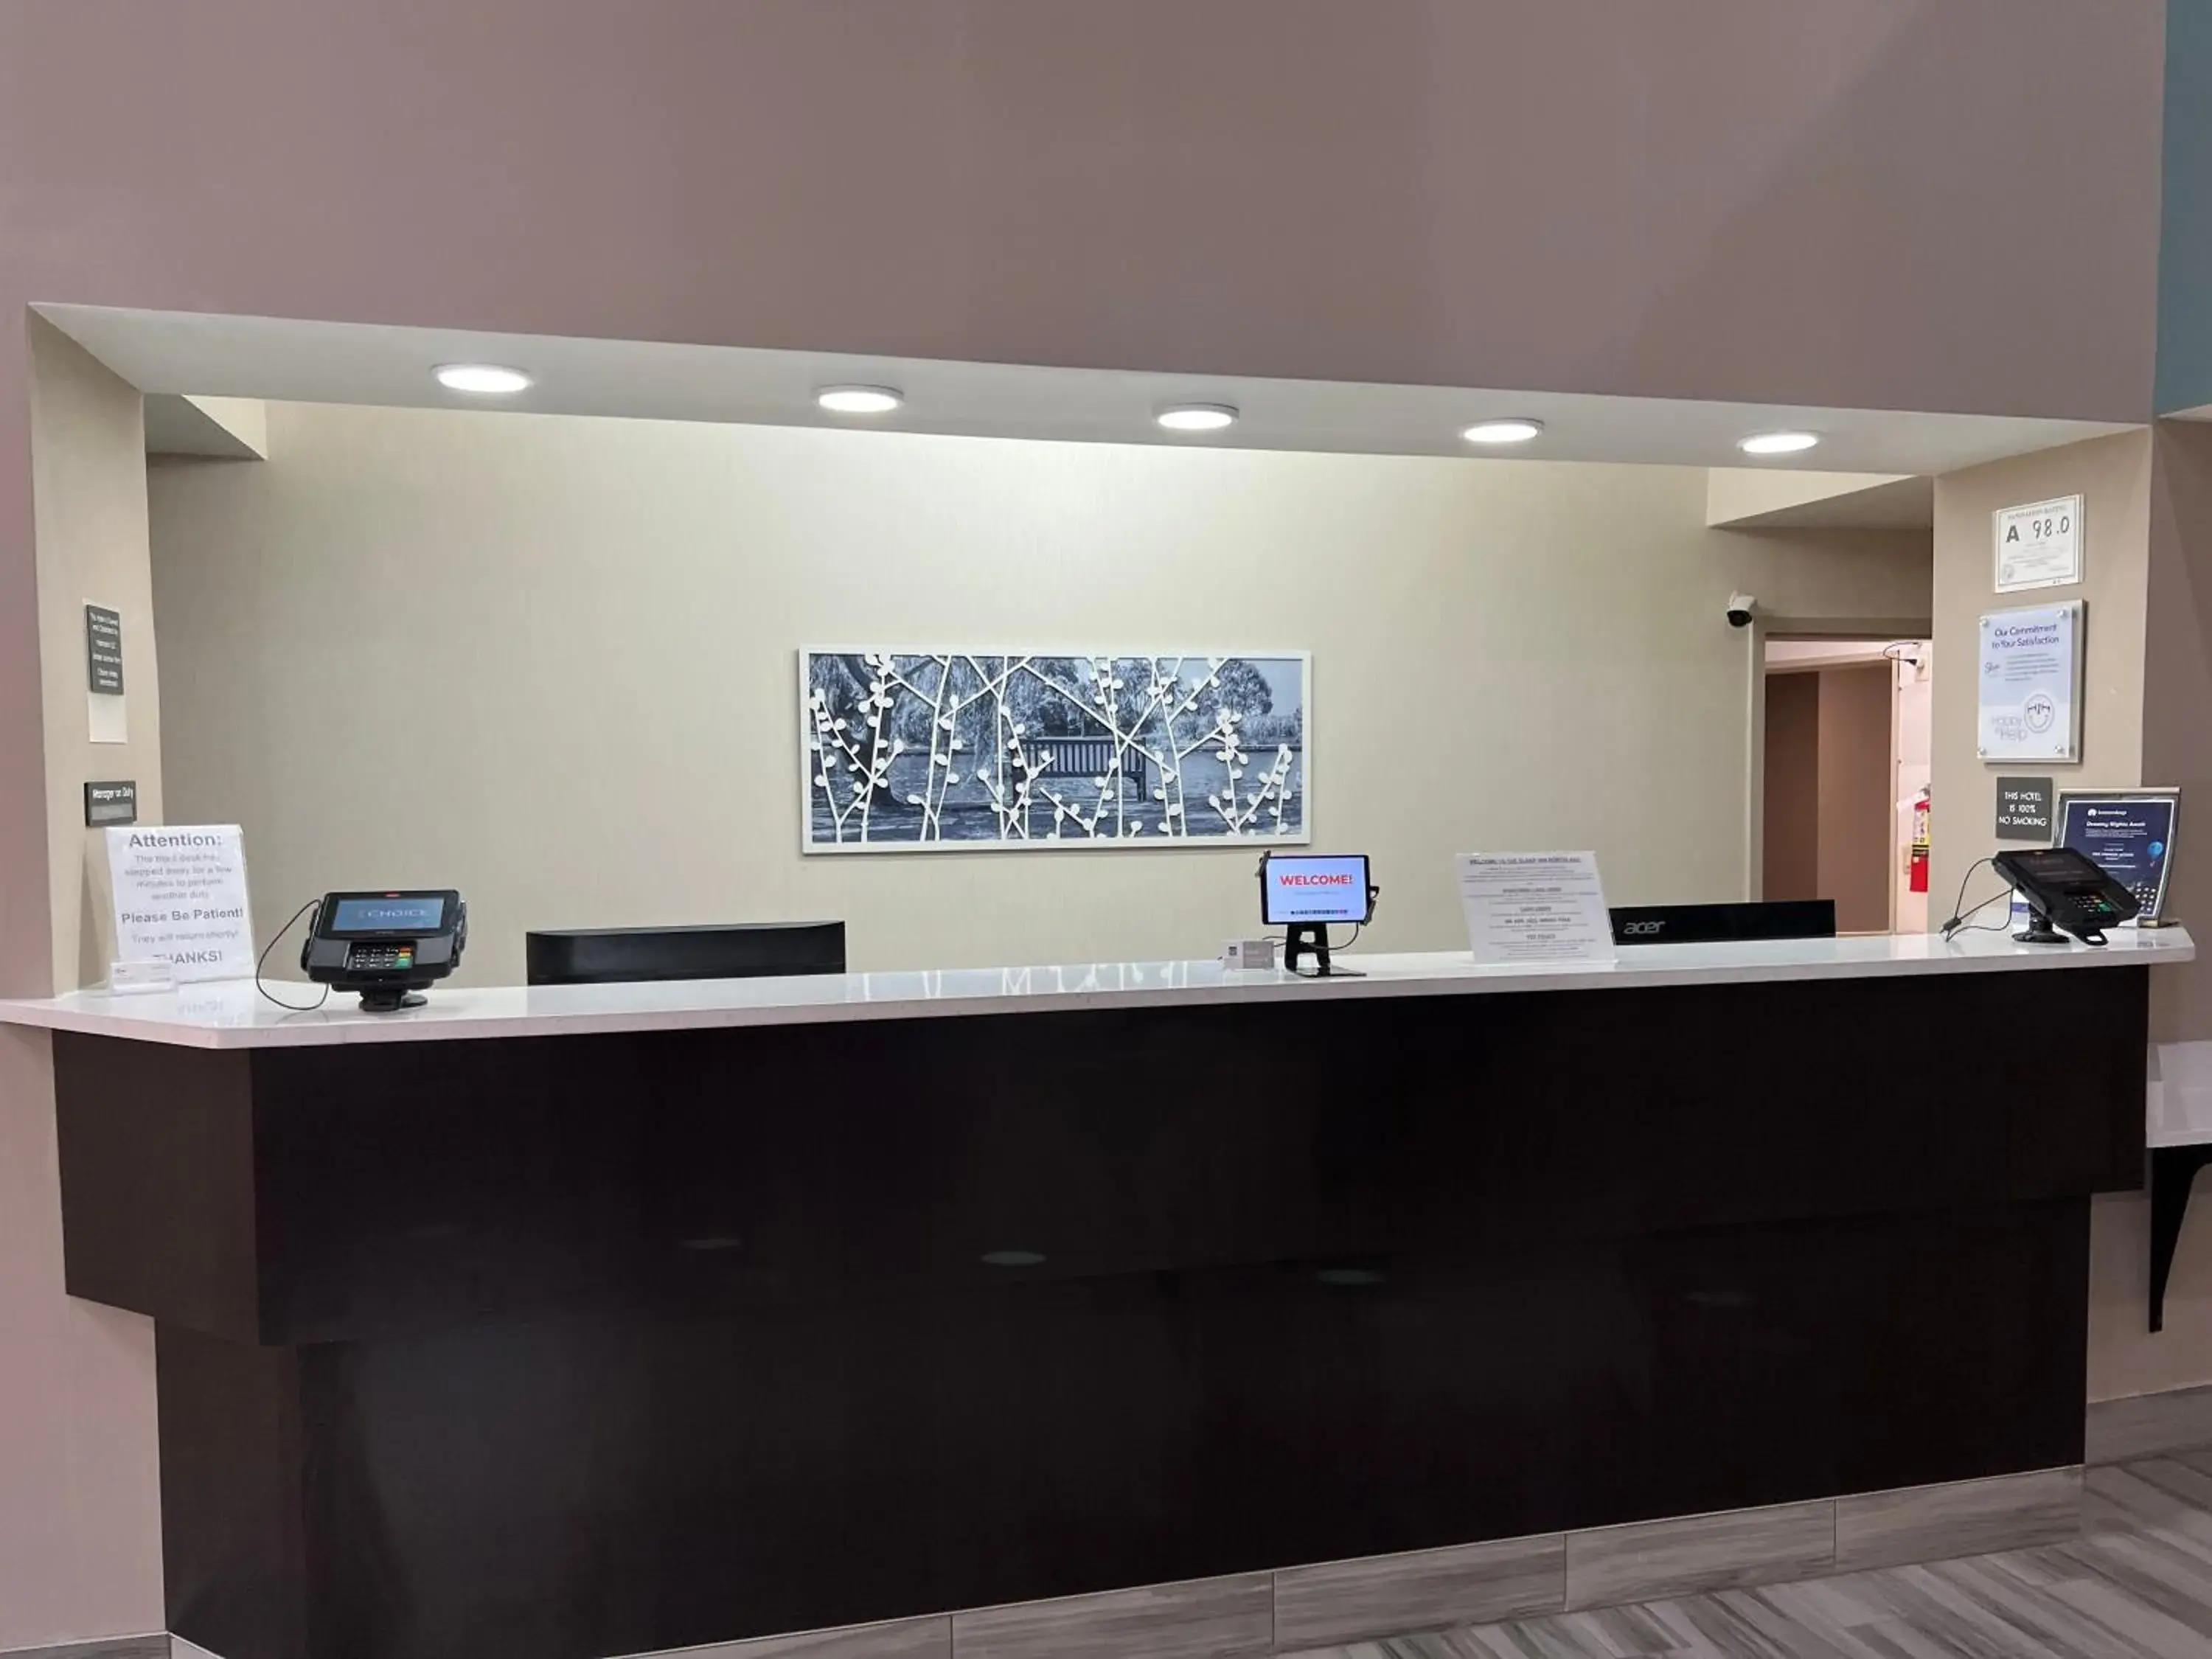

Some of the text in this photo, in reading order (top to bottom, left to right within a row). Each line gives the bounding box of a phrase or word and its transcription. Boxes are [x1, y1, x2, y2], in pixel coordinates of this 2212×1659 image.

[2006, 516, 2070, 543] A 98.0
[1994, 624, 2057, 636] Our Commitment
[2017, 636, 2059, 647] Satisfaction
[2005, 791, 2042, 801] THIS HOTEL
[2009, 804, 2036, 813] IS 100%
[1999, 816, 2048, 827] NO SMOKING
[129, 833, 222, 847] Attention:
[1280, 874, 1353, 886] WELCOME!
[122, 908, 243, 925] Please Be Patient!
[1624, 920, 1666, 934] acer
